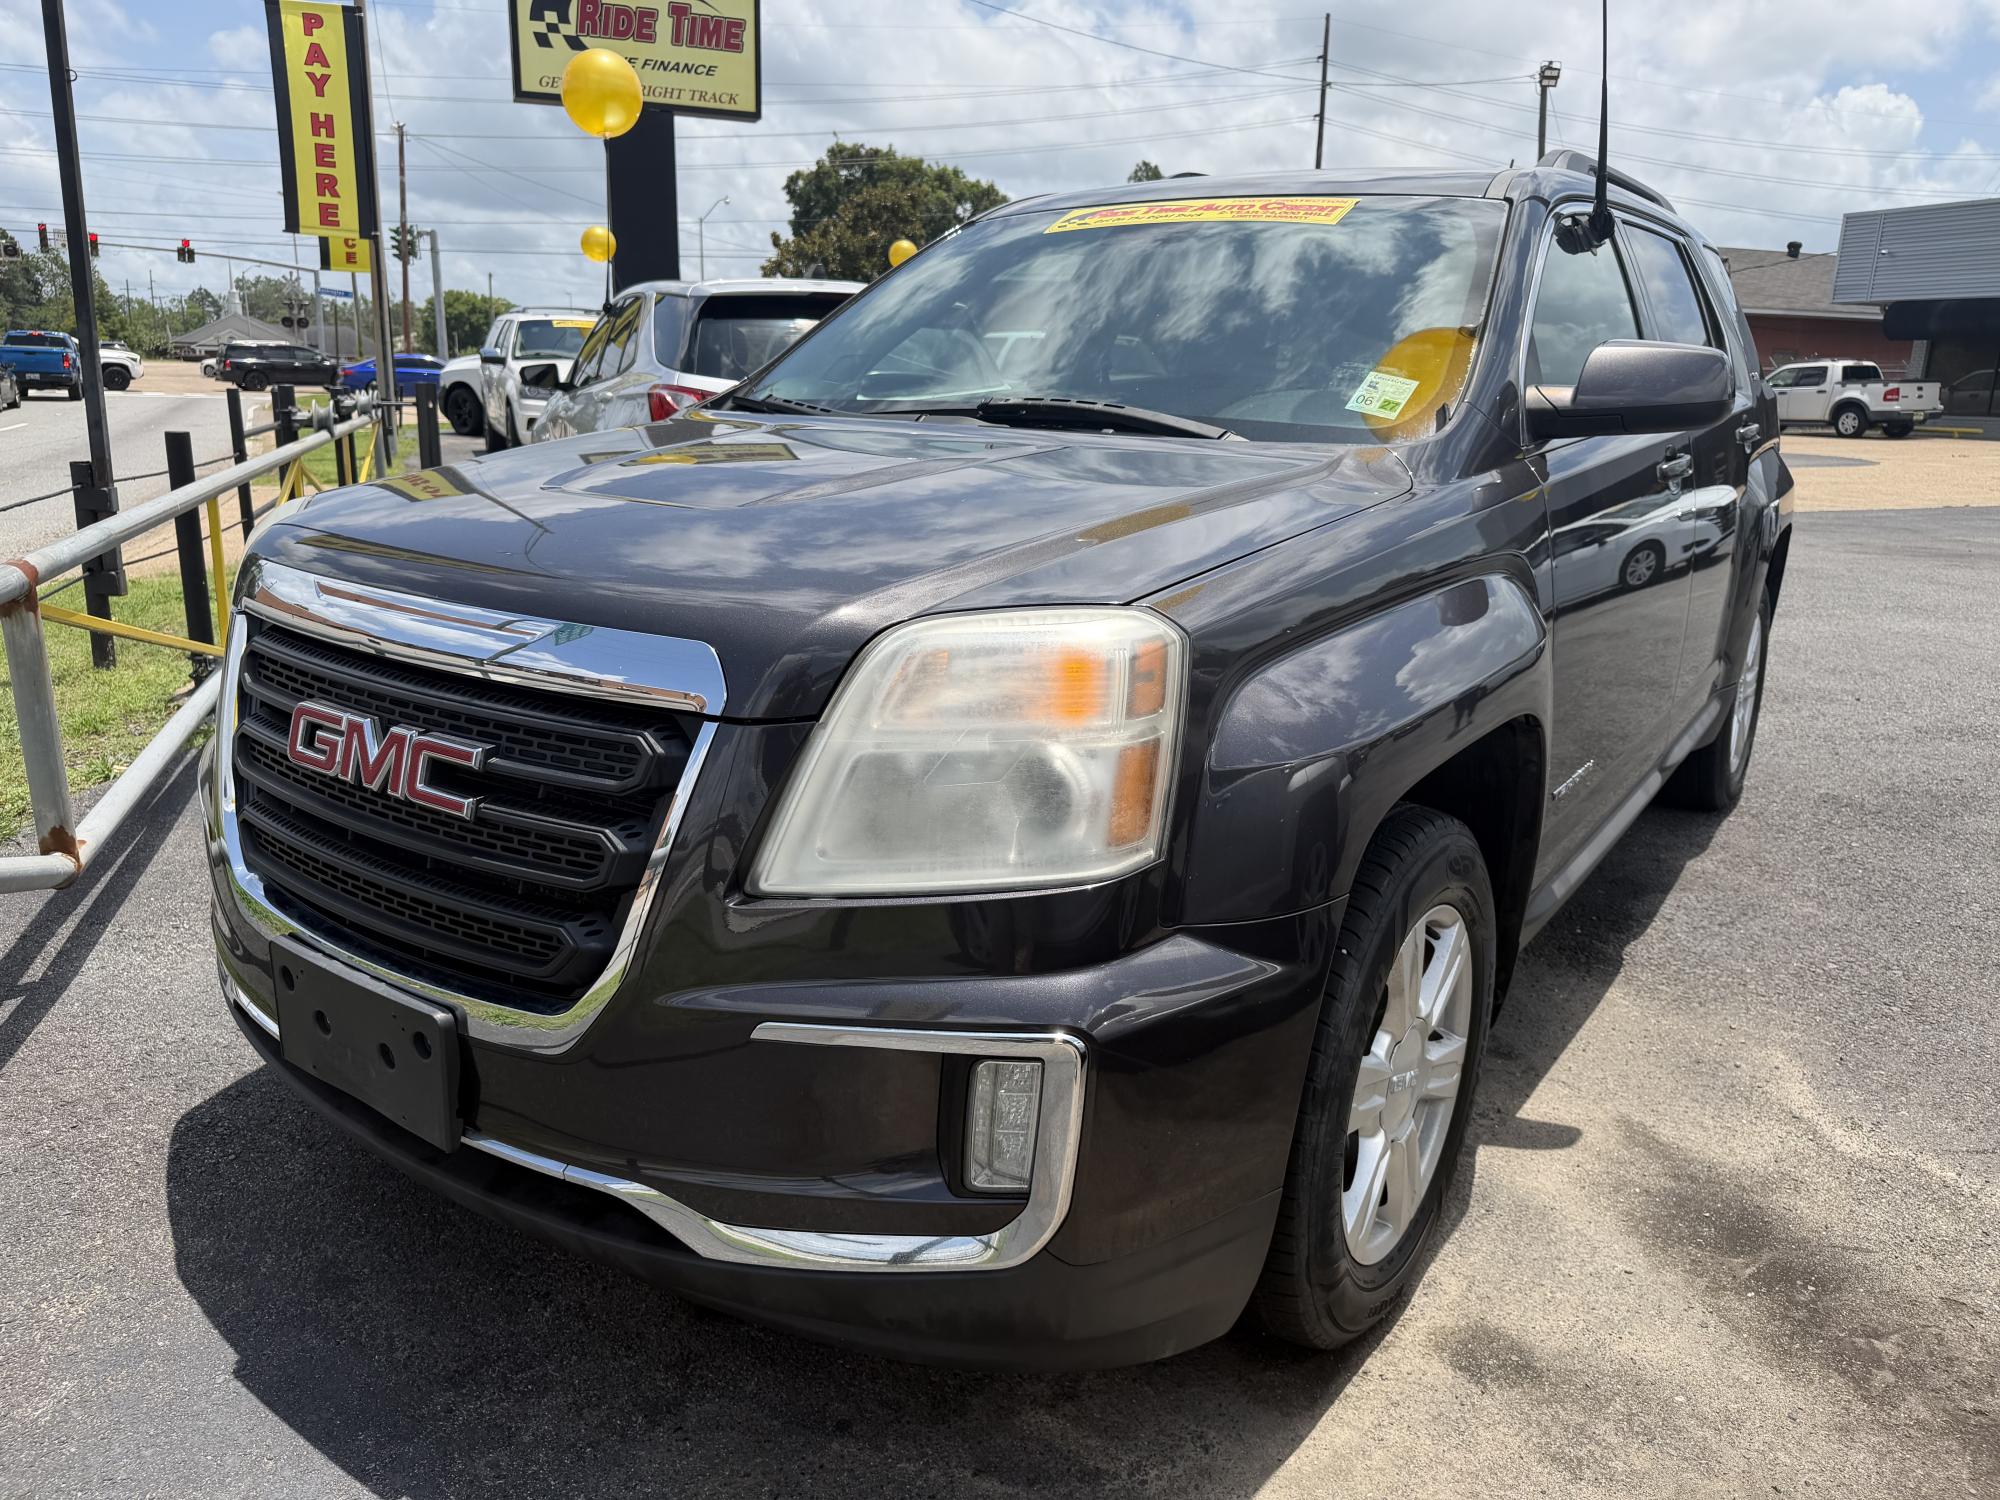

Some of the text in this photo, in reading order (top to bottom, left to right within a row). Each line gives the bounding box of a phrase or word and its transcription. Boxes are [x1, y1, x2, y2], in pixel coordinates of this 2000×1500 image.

[577, 0, 747, 53] RIDE TIME
[641, 58, 718, 77] FINANCE
[538, 74, 562, 89] GE
[689, 88, 740, 105] TRACK
[302, 12, 341, 227] PAY HERE
[1355, 394, 1400, 412] 06 27
[287, 699, 485, 821] GMC
